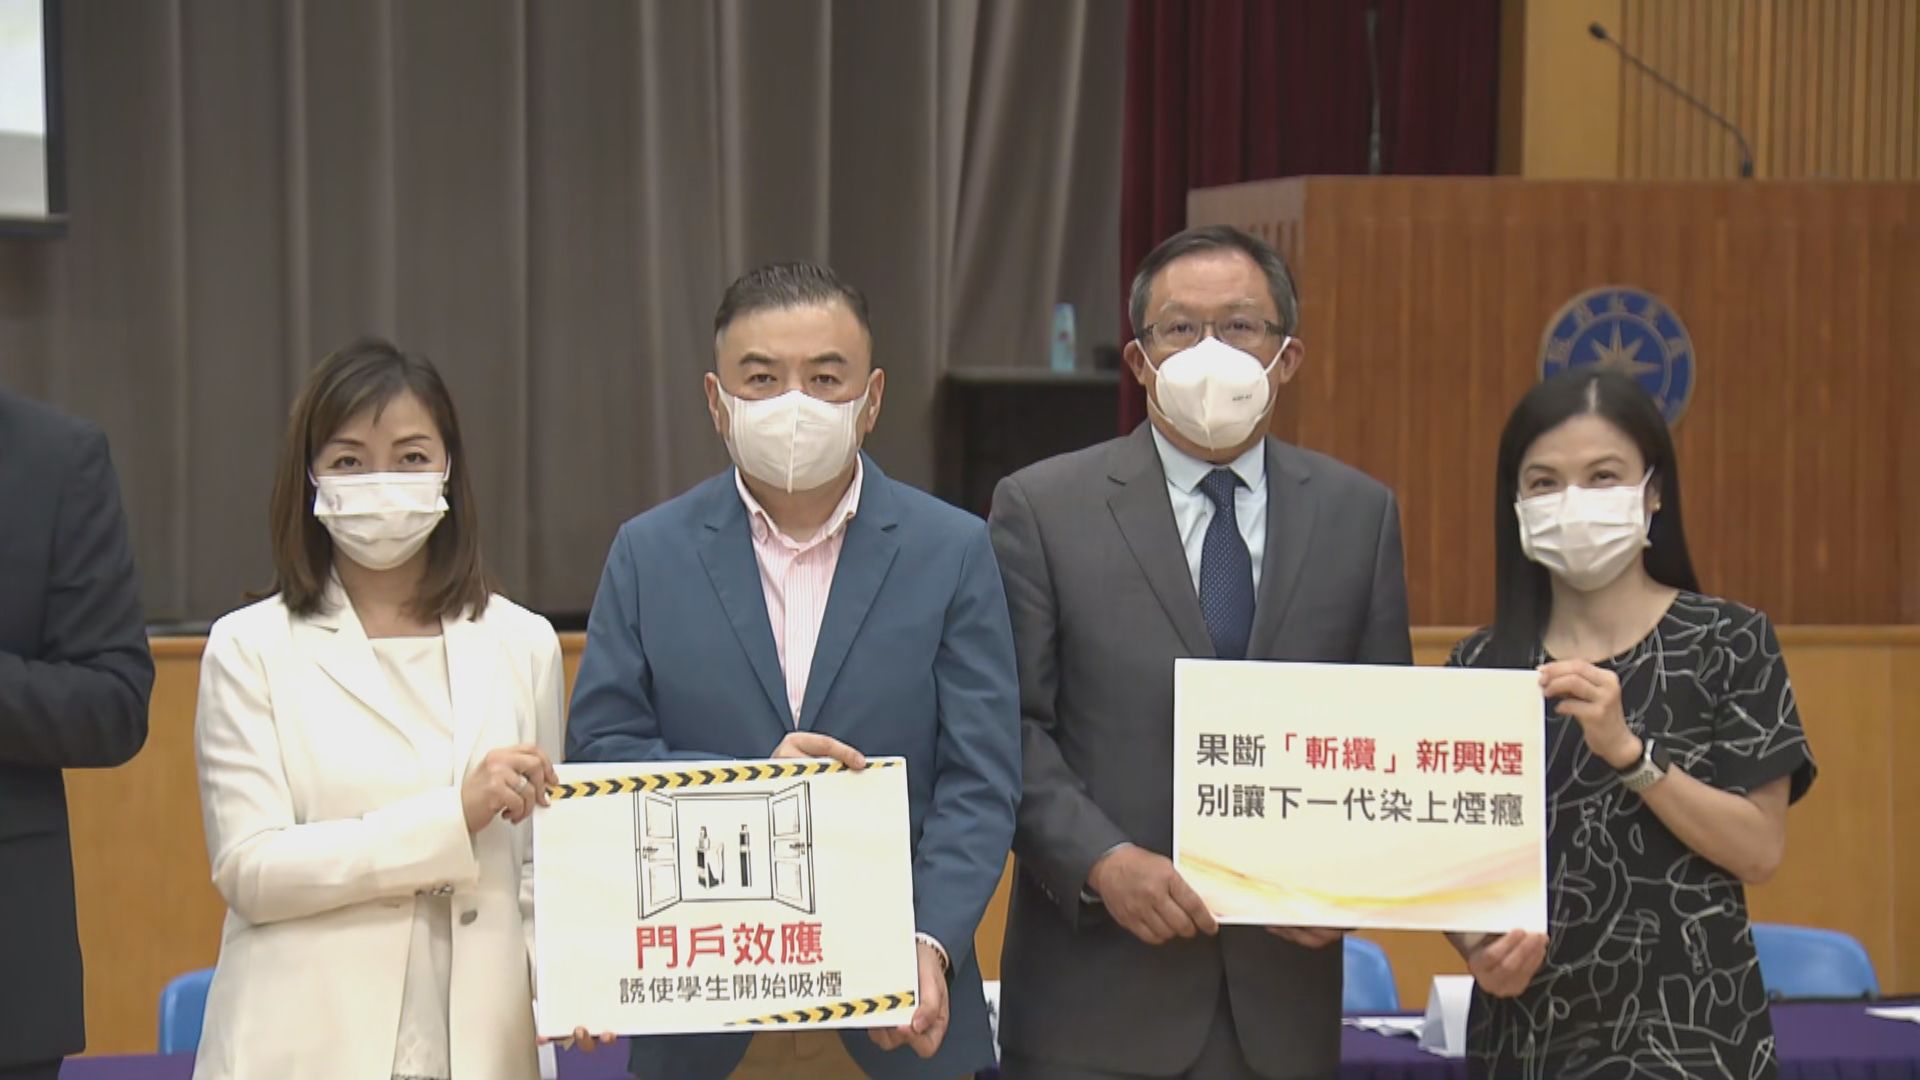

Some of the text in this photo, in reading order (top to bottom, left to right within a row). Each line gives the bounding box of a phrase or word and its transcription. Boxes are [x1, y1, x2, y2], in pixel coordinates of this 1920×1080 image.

[1197, 784, 1524, 826] 別讓下一代染上煙癮
[636, 921, 824, 970] 門戶效應
[619, 971, 842, 1004] 誘使學生開始吸煙
